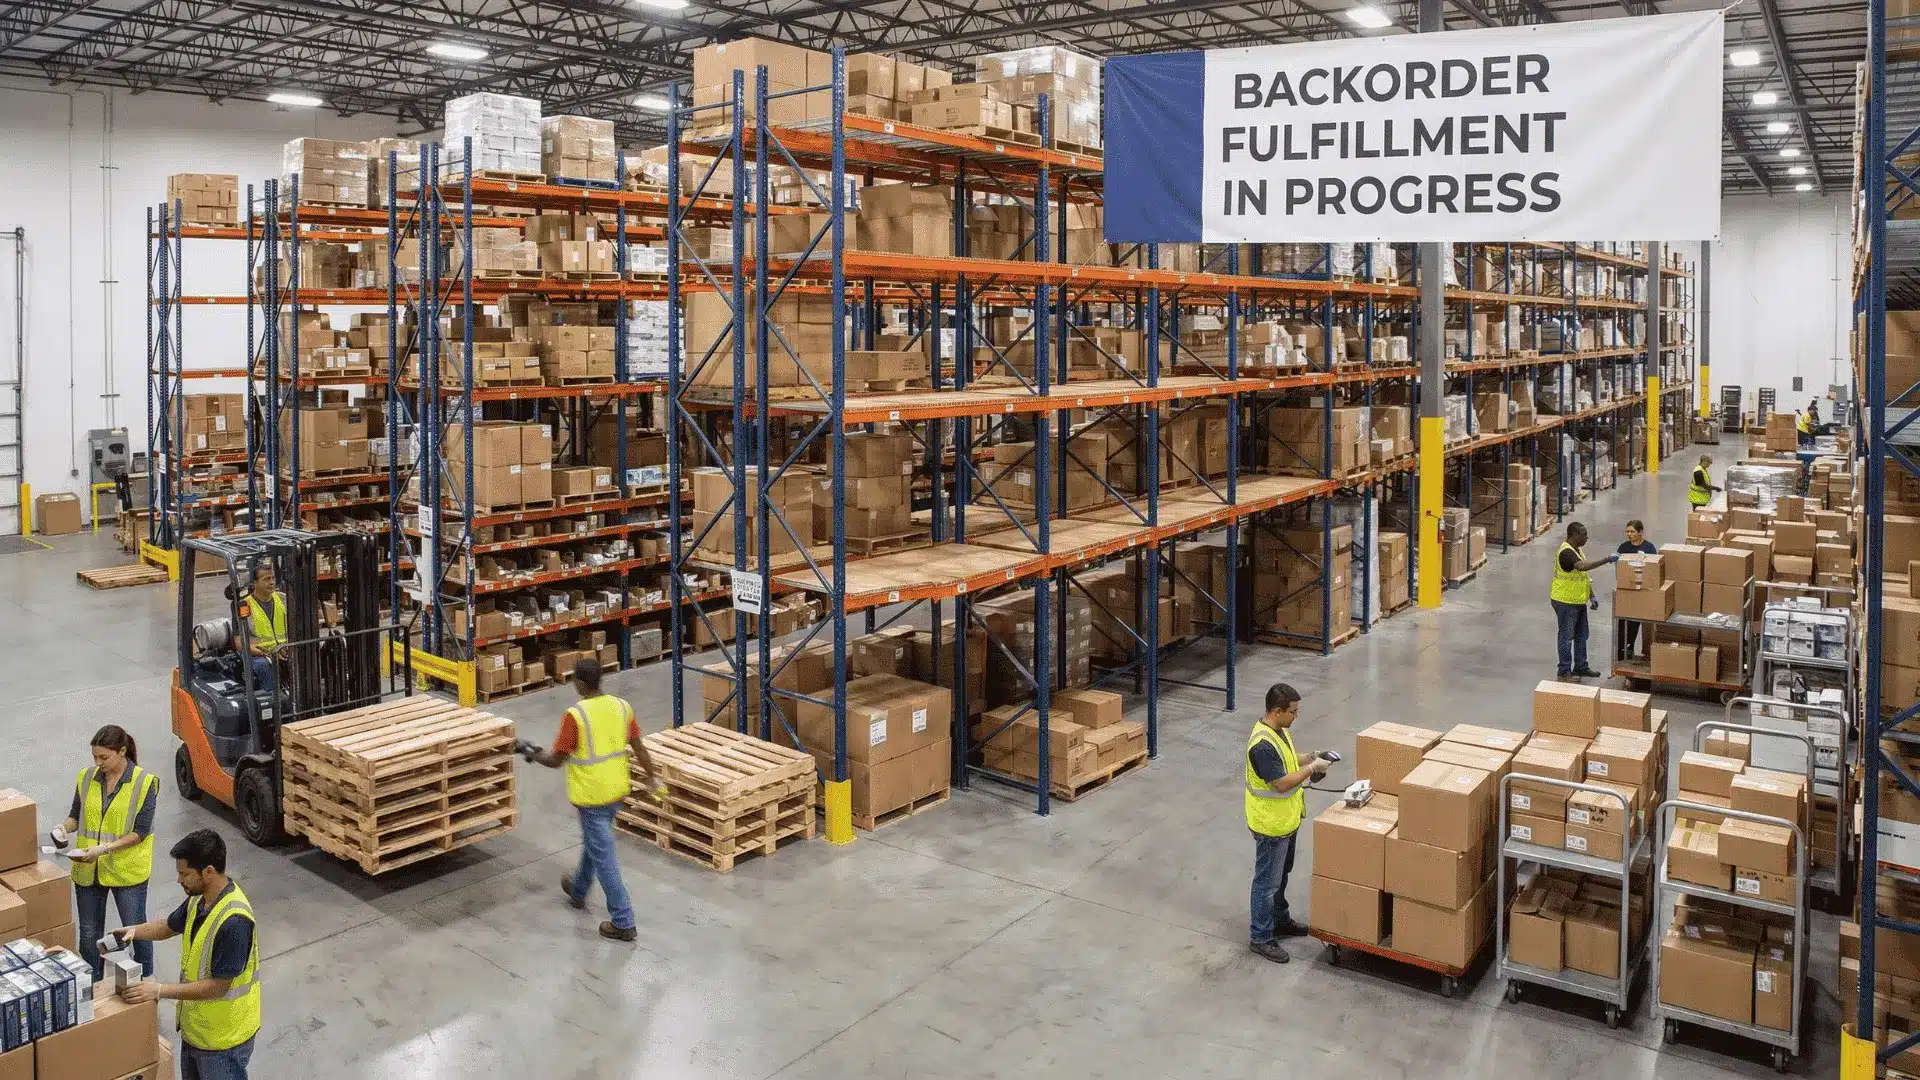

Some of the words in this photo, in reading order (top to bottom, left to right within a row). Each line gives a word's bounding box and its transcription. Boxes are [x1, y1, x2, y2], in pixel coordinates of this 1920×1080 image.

[1235, 54, 1549, 109] BACKORDER
[1223, 112, 1567, 163] FULFILLMENT
[1223, 179, 1267, 216] IN
[1286, 172, 1561, 215] PROGRESS
